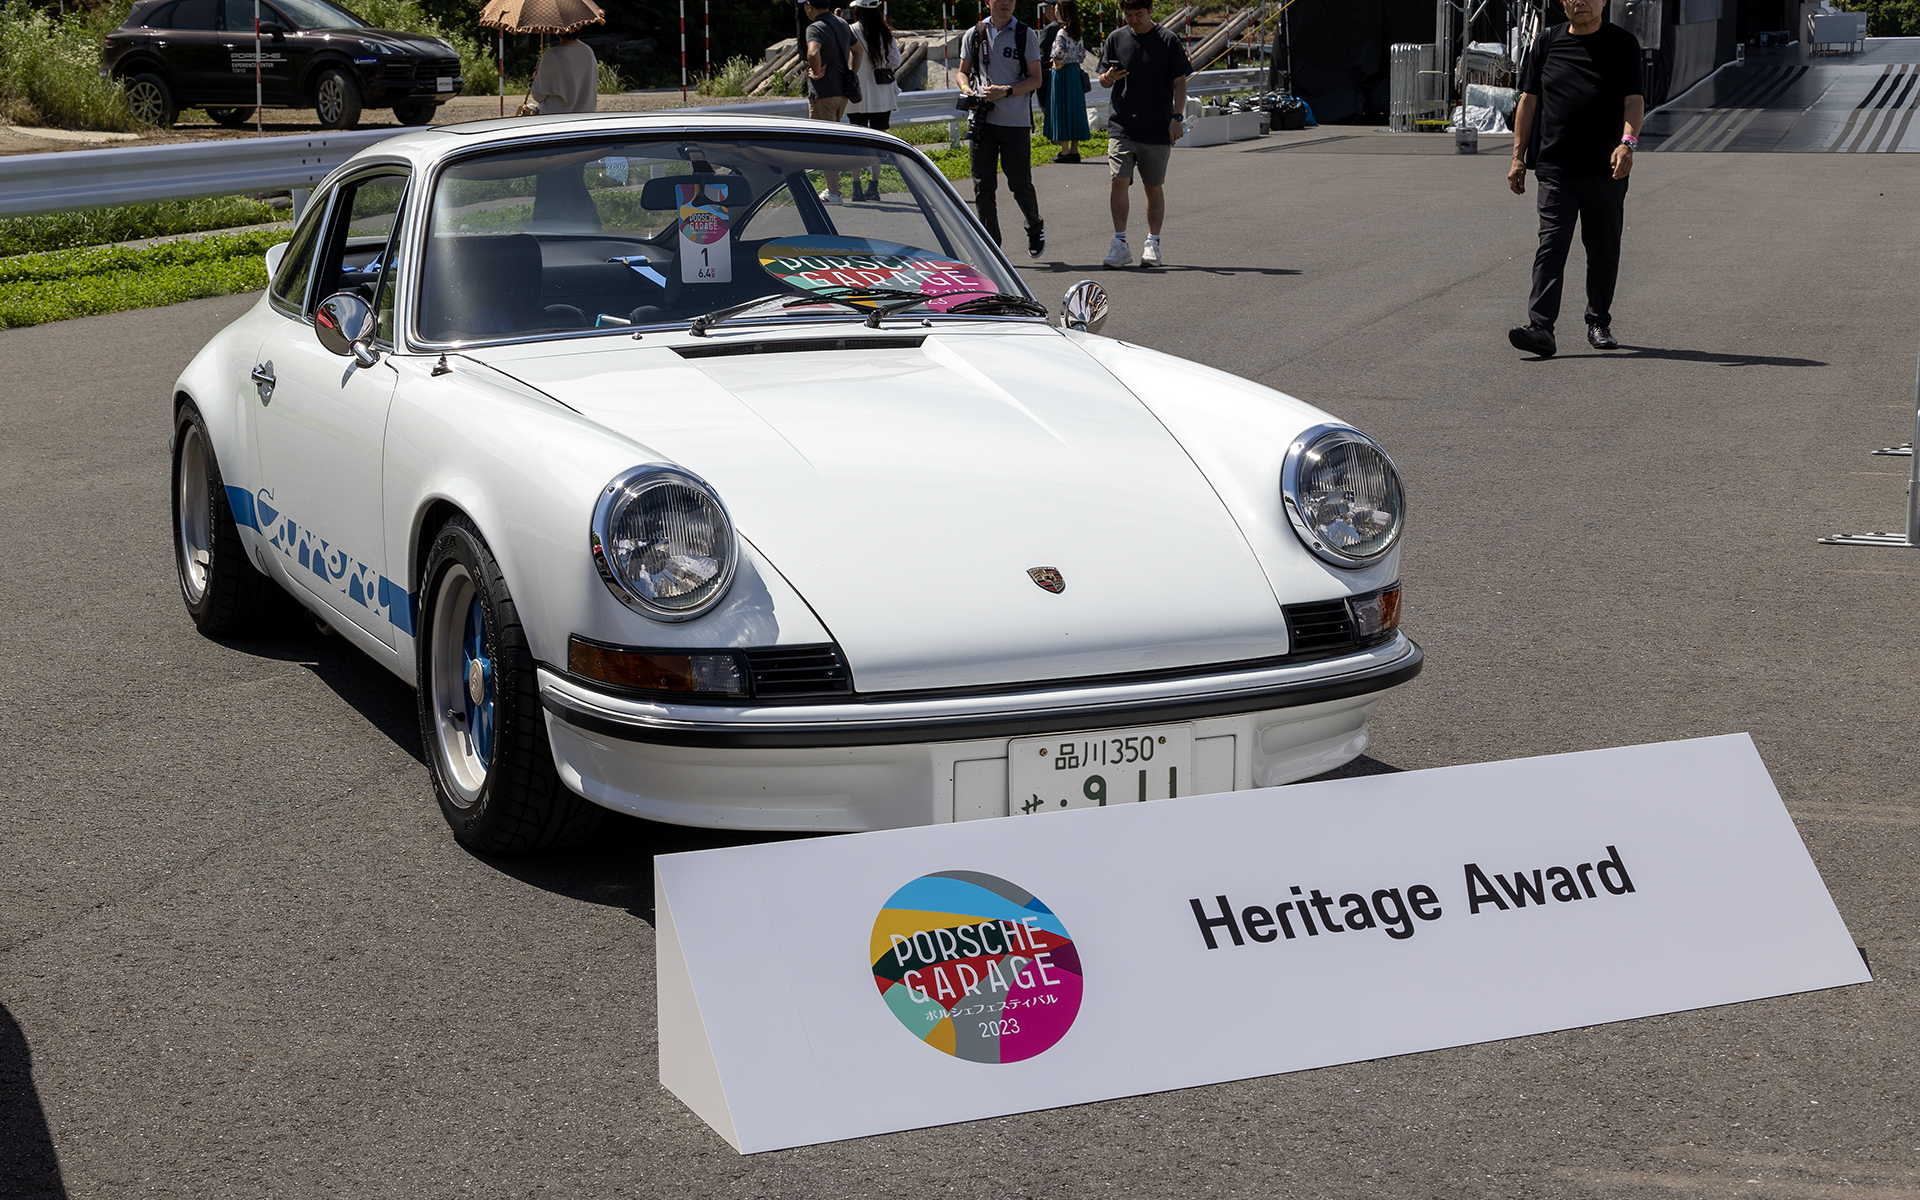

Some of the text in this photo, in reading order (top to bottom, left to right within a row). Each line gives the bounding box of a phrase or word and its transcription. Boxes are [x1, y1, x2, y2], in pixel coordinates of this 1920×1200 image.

[689, 213, 718, 222] PORSCHE
[689, 222, 718, 231] GARAGE
[700, 247, 709, 267] 1
[791, 246, 850, 255] Heritage
[773, 254, 953, 272] PORSCHE
[798, 270, 979, 288] GARAGE
[254, 487, 391, 621] Carrera
[1188, 845, 1636, 951] Heritage Award
[890, 916, 1048, 967] PORSCHE
[903, 952, 1061, 1004] GARAGE
[924, 994, 1059, 1021] ポルシェフェスティバル
[978, 1018, 1021, 1038] 2023
